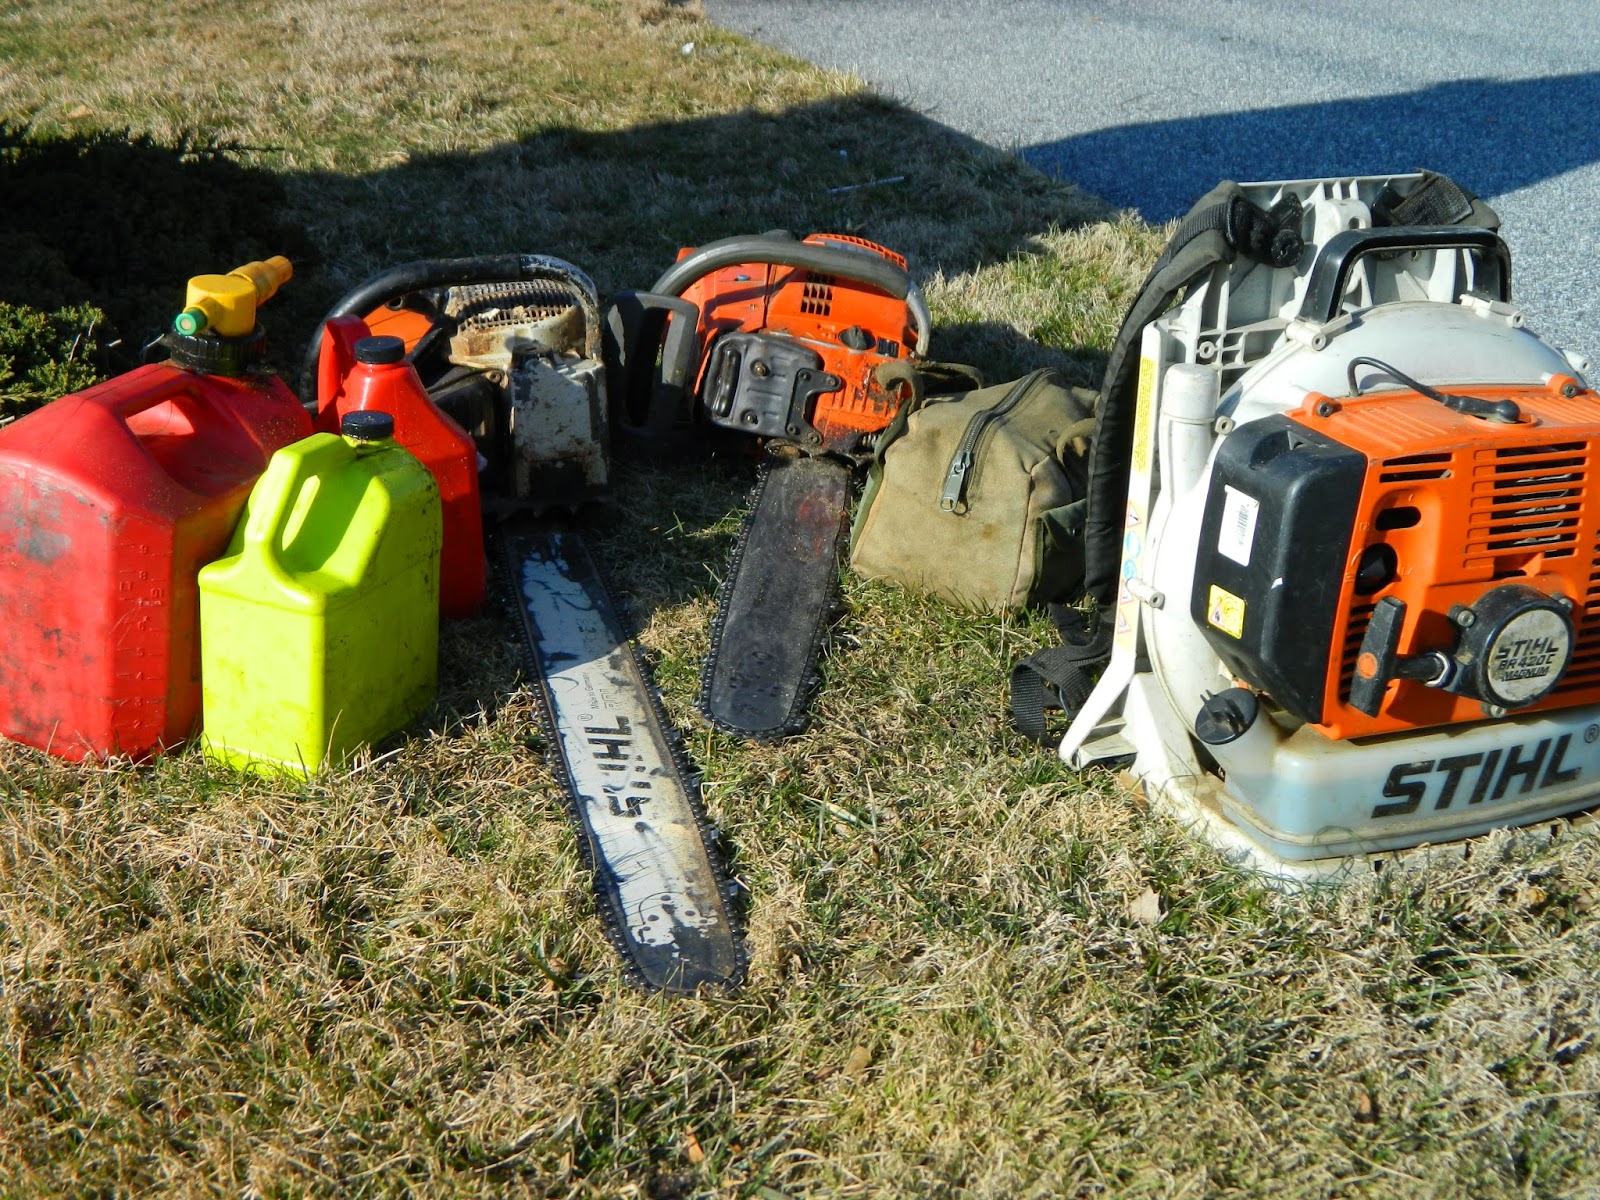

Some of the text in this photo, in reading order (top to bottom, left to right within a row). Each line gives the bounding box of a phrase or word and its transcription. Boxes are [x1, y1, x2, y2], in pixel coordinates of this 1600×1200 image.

[1494, 637, 1560, 660] STIHL
[1501, 665, 1550, 682] MAGNUM
[1371, 733, 1582, 819] STIHL
